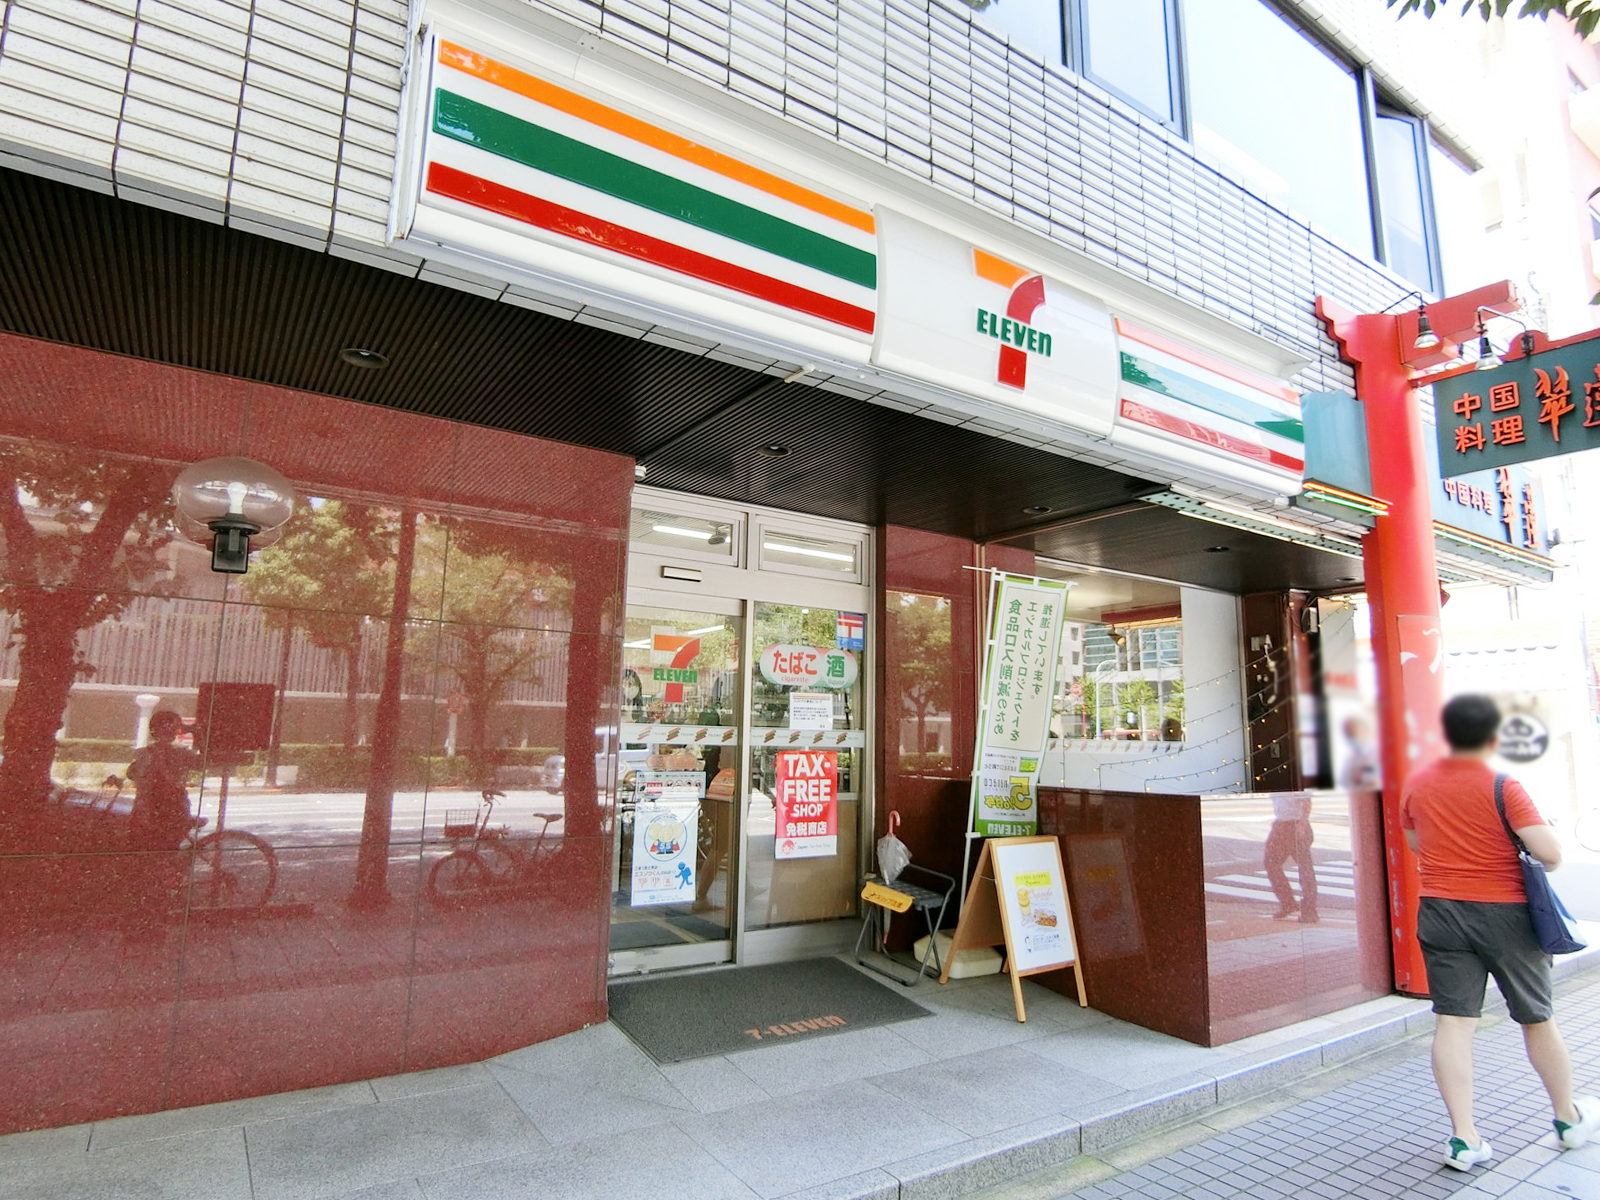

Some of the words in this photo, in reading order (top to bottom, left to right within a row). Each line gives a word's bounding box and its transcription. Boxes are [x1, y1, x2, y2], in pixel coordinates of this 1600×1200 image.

[973, 247, 1045, 390] 7
[1452, 381, 1520, 420] 中国
[1453, 414, 1526, 453] 料理
[1443, 478, 1492, 516] 中国料理
[773, 649, 818, 675] たばこ
[826, 654, 845, 678] 酒
[781, 675, 809, 683] cigarette
[783, 754, 831, 777] TAX-
[783, 779, 831, 803] FREE
[792, 803, 823, 817] SHOP
[786, 821, 828, 837] 免税商店
